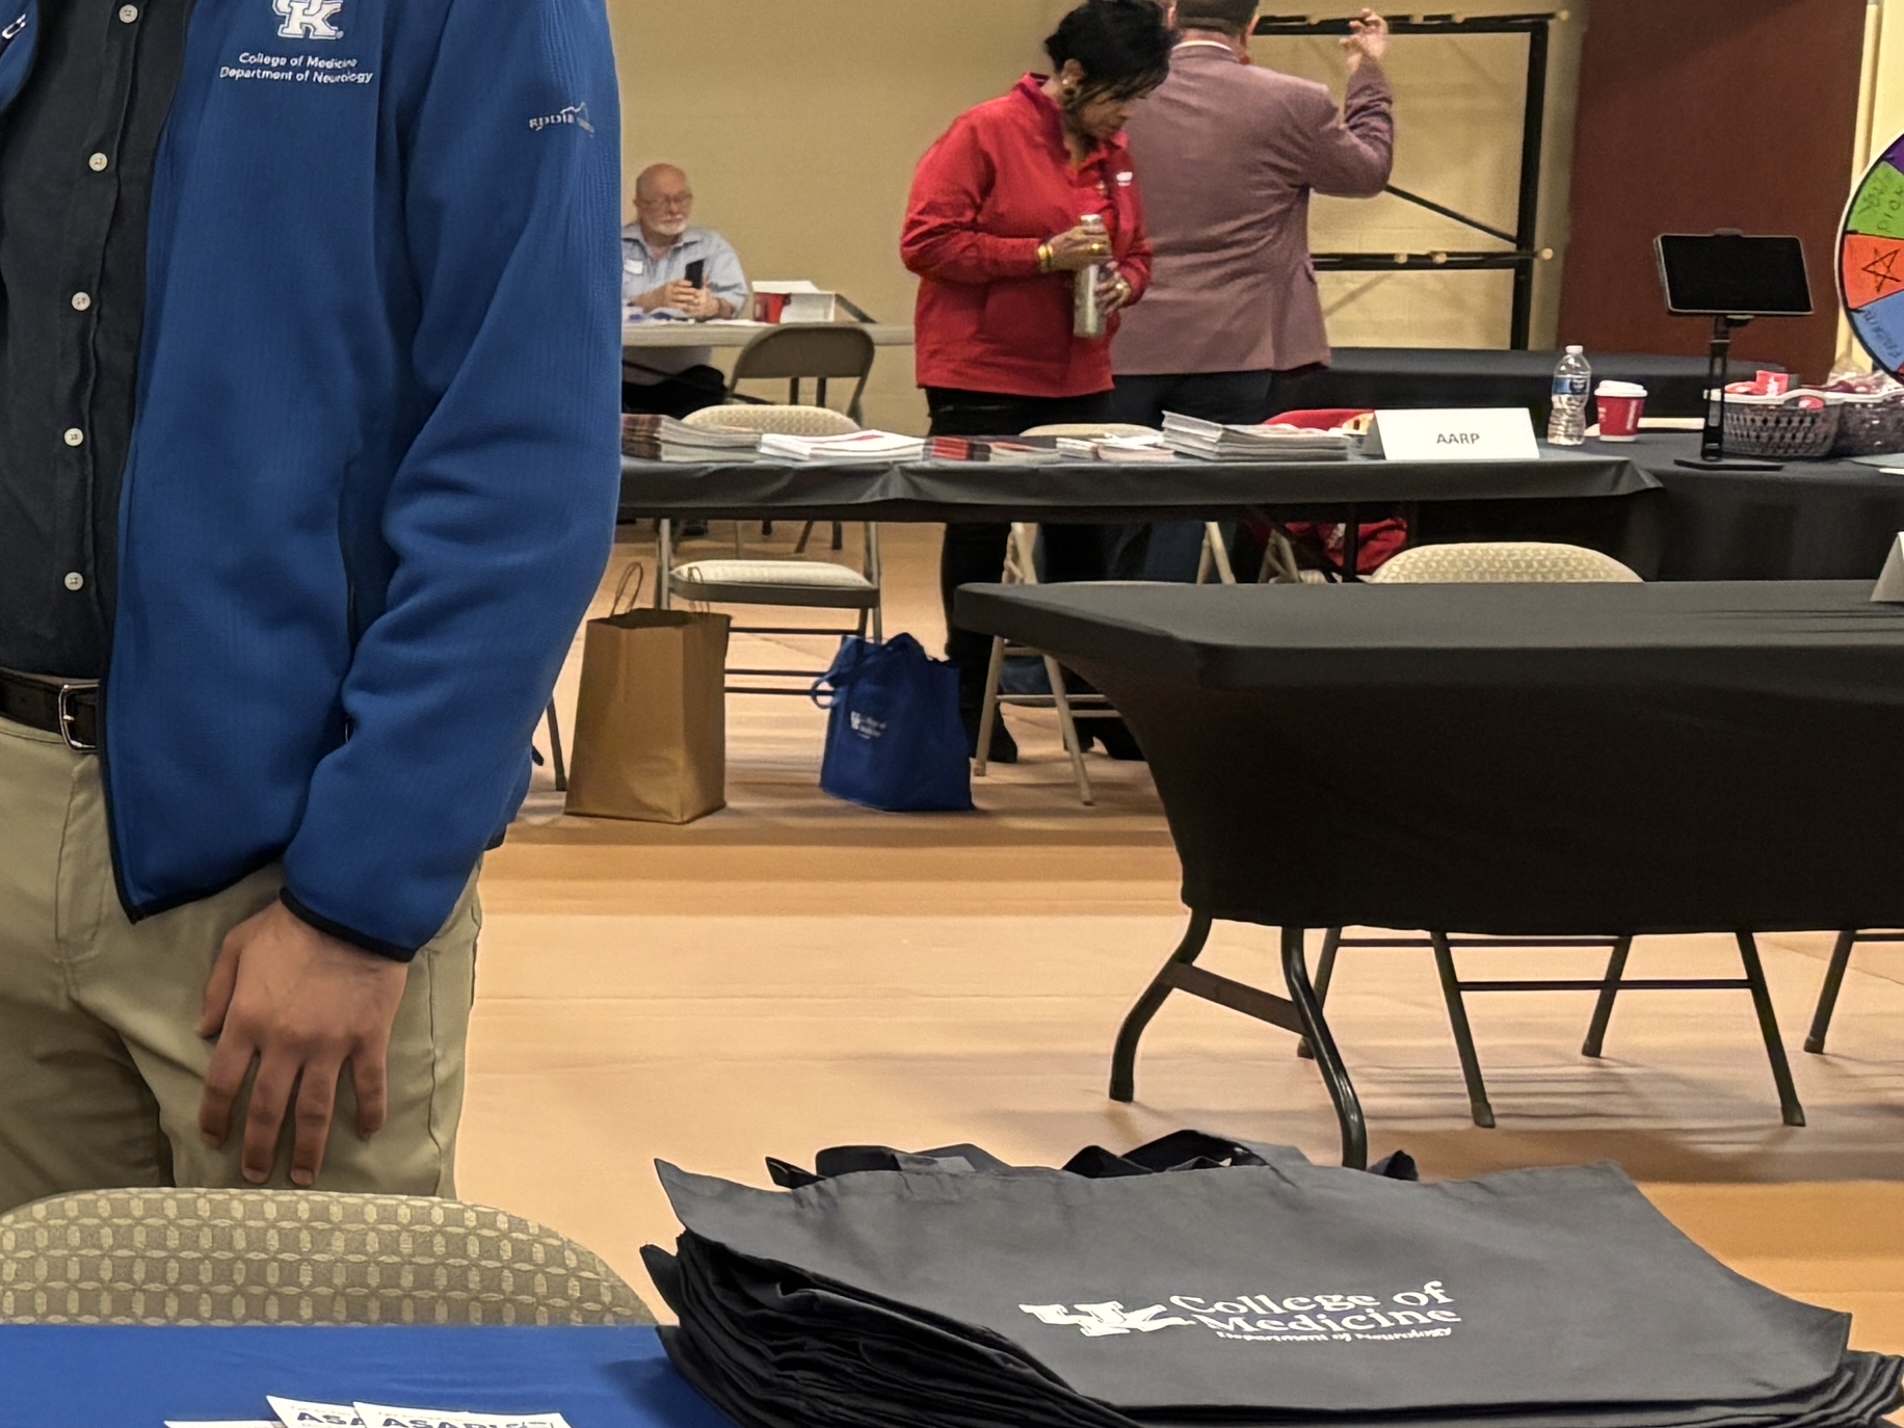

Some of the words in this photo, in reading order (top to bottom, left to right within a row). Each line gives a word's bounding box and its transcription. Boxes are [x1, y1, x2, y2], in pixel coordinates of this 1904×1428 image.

[239, 52, 287, 68] College
[290, 55, 305, 67] of
[307, 55, 358, 70] Medicine
[220, 67, 293, 81] Department
[296, 70, 310, 83] of
[313, 71, 374, 84] Neurology
[1435, 432, 1481, 446] AARP
[1168, 1293, 1382, 1315] College
[1392, 1279, 1457, 1306] of
[1192, 1305, 1463, 1333] Medicine
